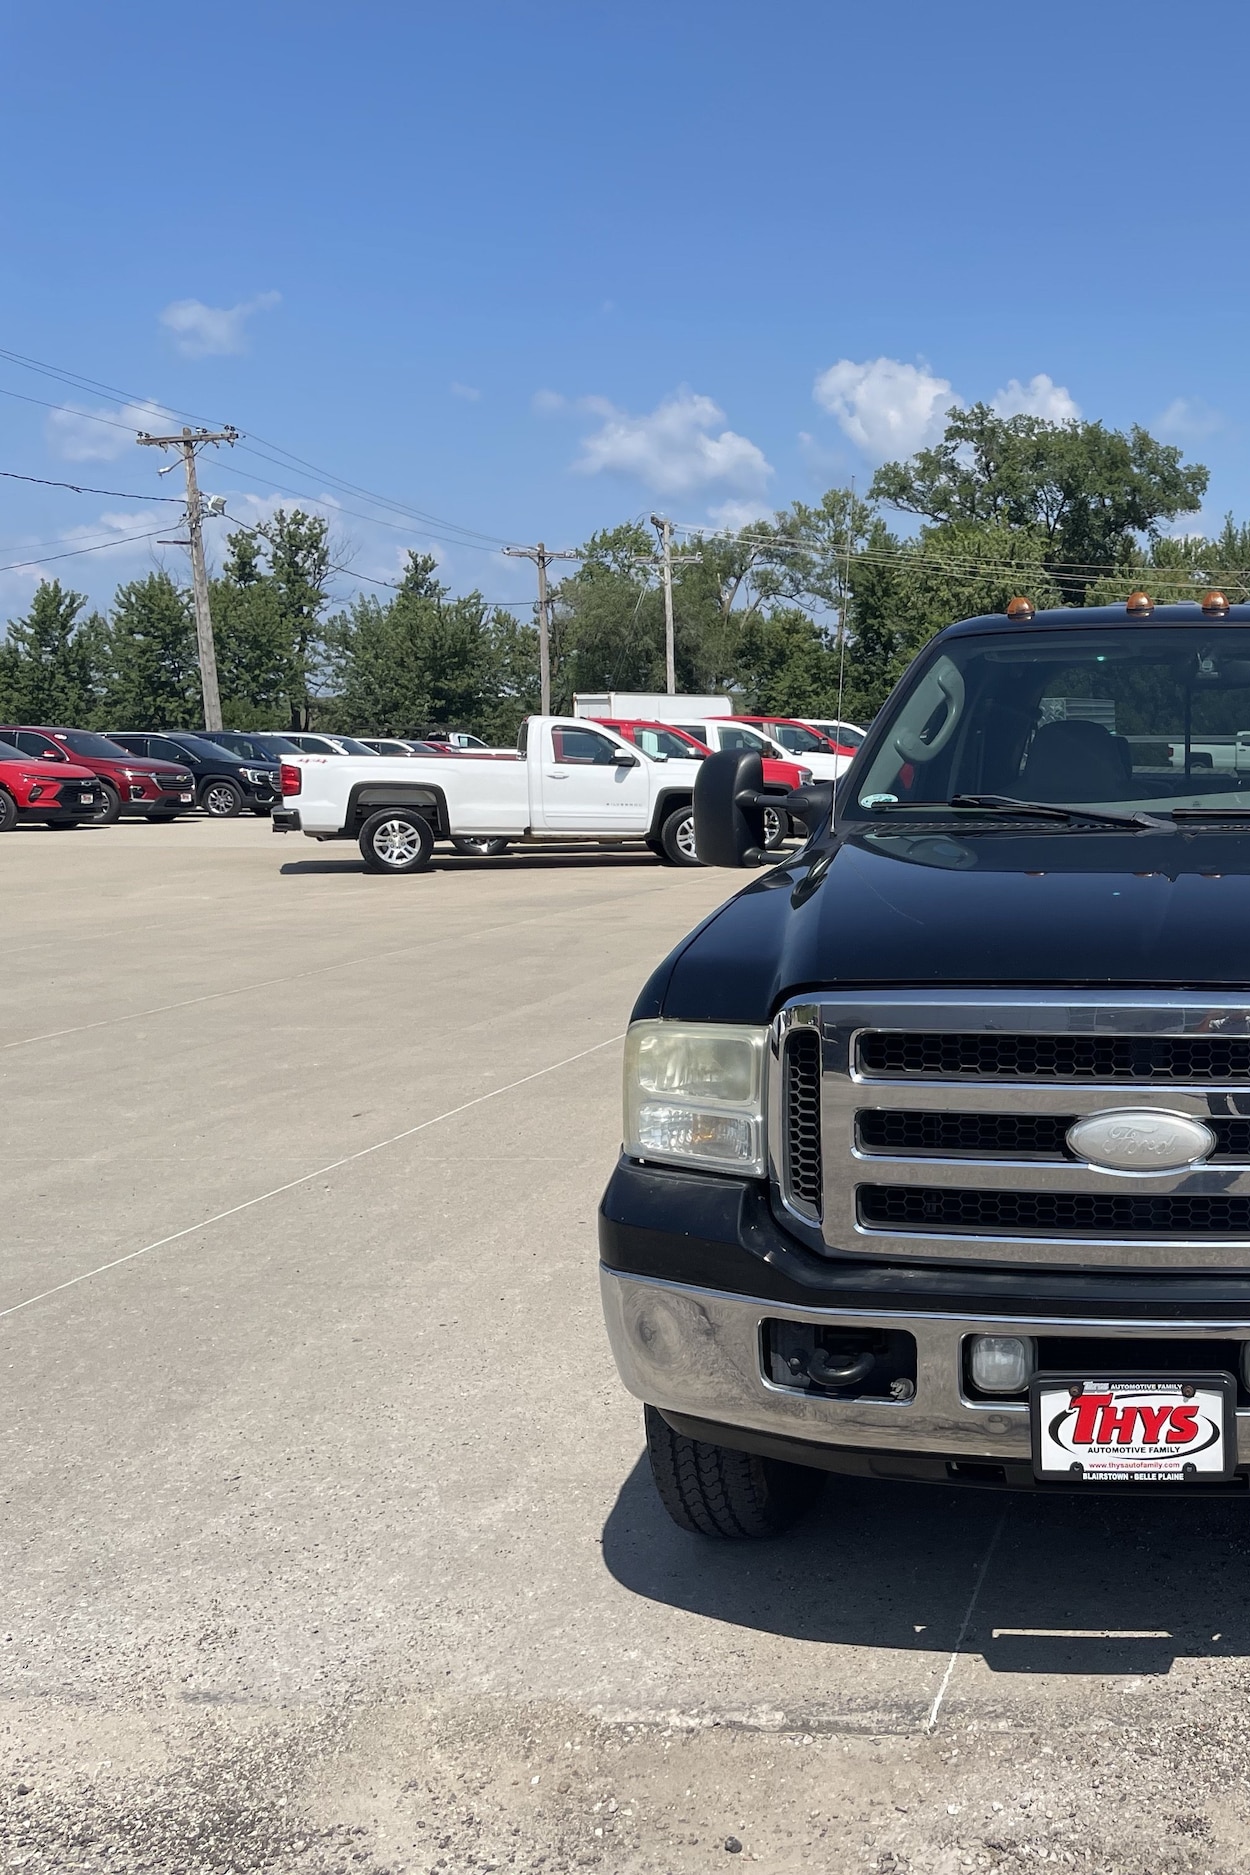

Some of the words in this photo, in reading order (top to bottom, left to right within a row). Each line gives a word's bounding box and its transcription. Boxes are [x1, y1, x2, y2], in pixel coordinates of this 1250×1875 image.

[1102, 1126, 1179, 1155] Ford
[1110, 1383, 1157, 1391] AUTOMOTIVE
[1157, 1383, 1183, 1391] FAMILY
[1069, 1393, 1200, 1445] THYS
[1087, 1446, 1146, 1454] AUTOMOTIVE
[1148, 1446, 1181, 1454] FAMILY
[1088, 1462, 1180, 1470] www.thysautofamily.com
[1082, 1472, 1129, 1480] BLAIRSTOWN
